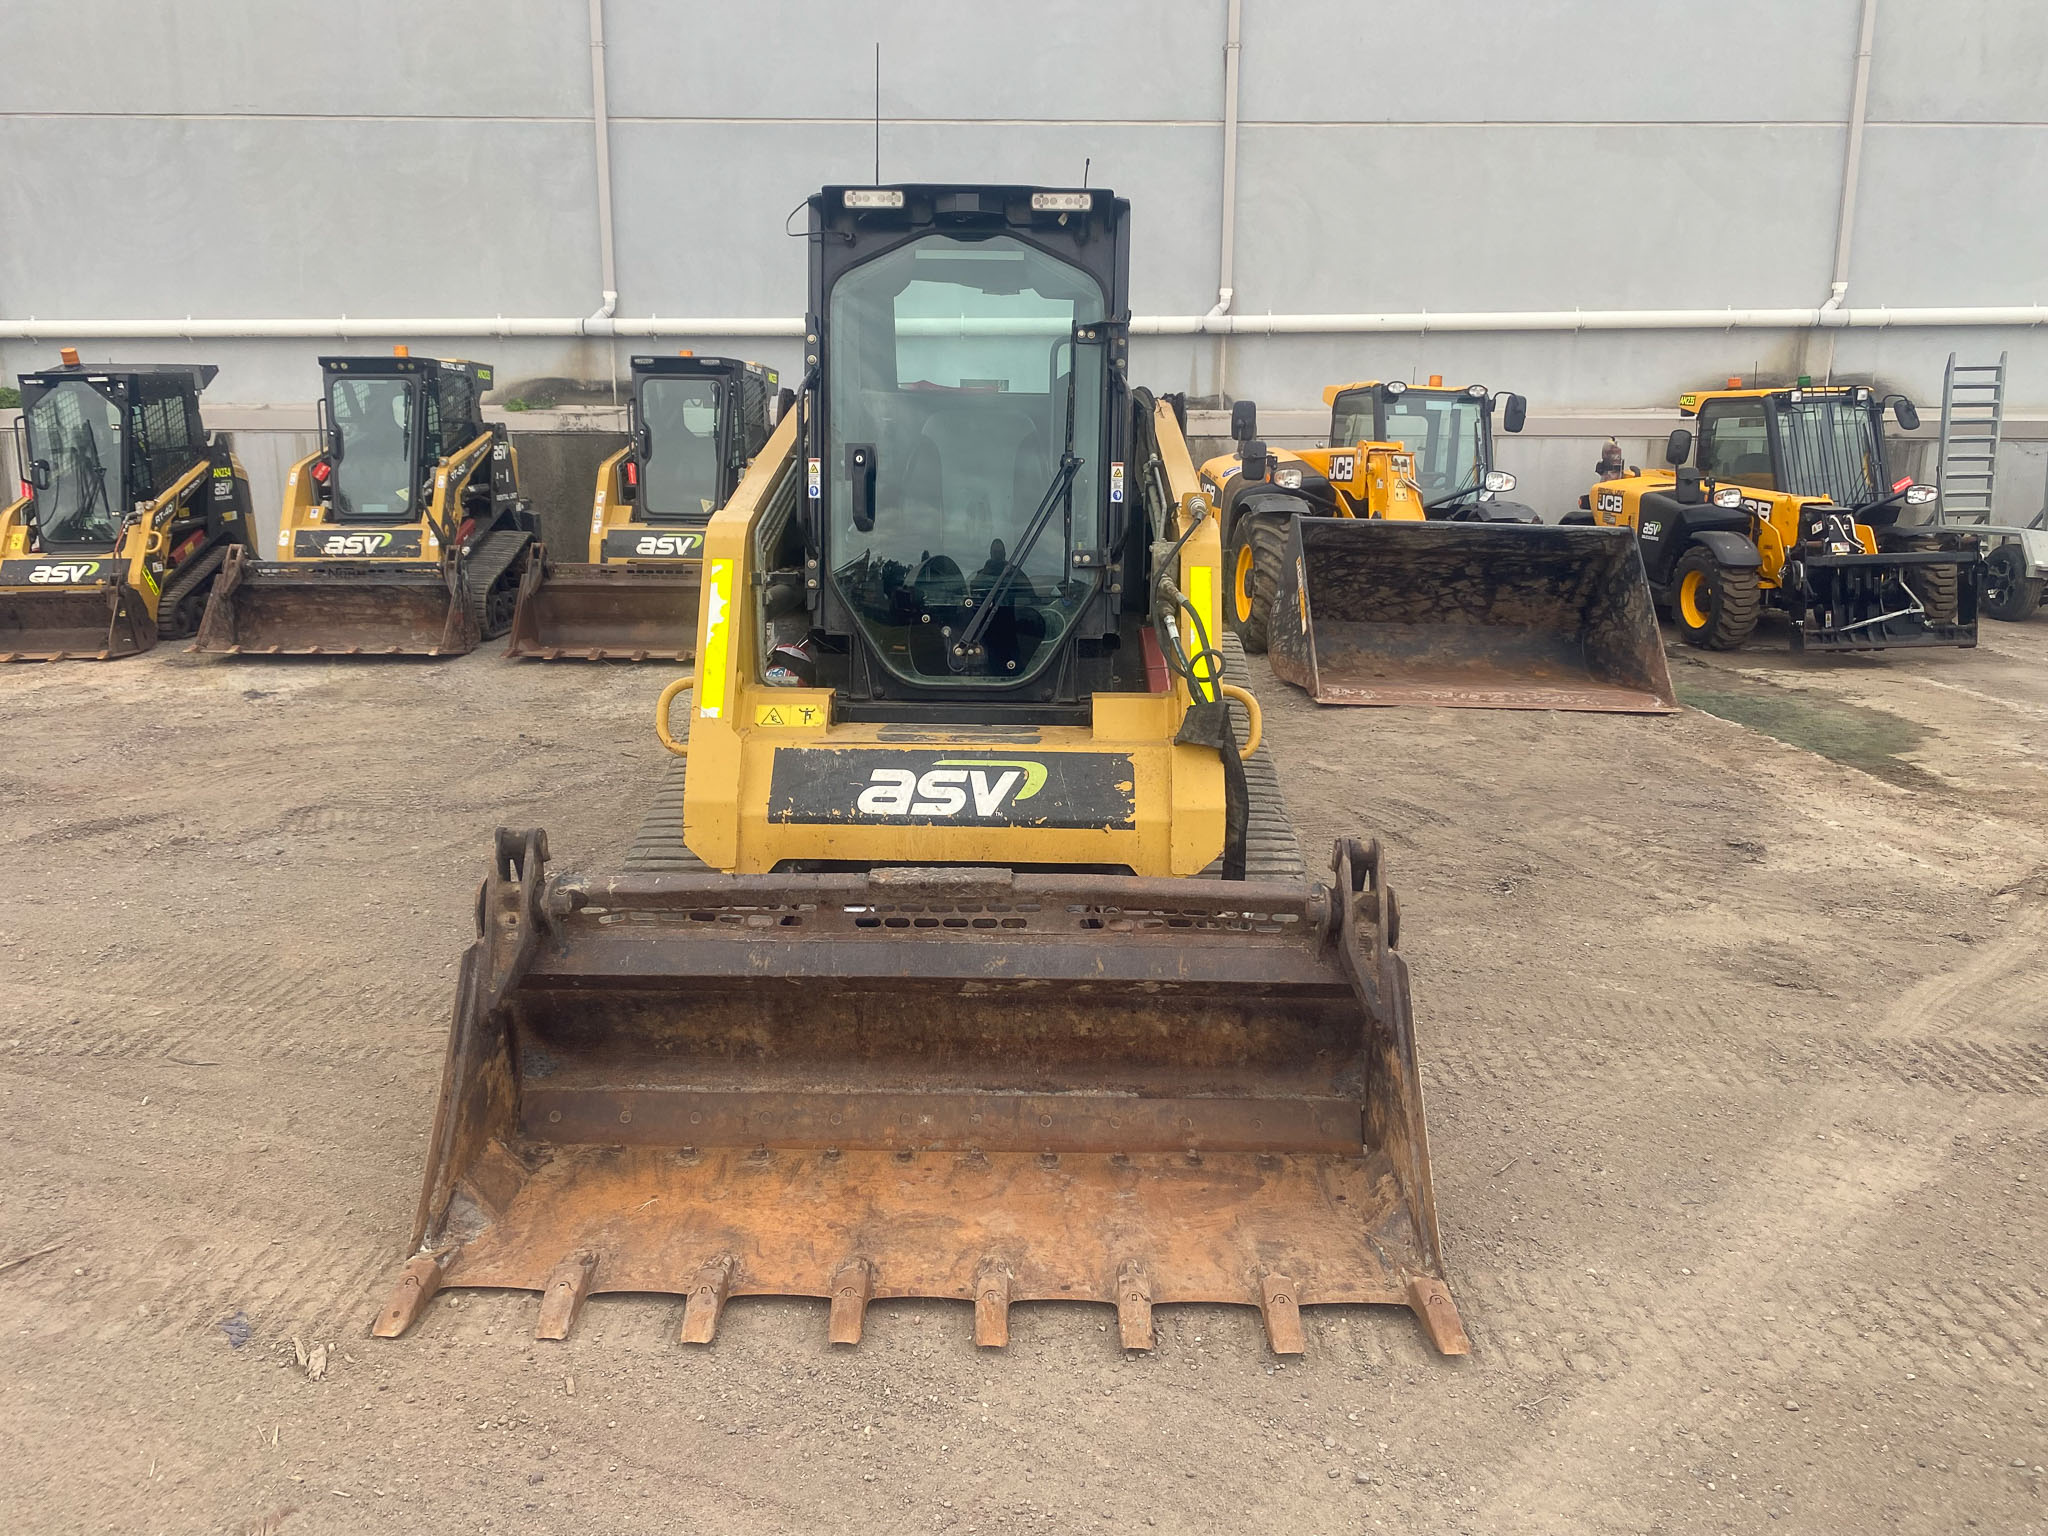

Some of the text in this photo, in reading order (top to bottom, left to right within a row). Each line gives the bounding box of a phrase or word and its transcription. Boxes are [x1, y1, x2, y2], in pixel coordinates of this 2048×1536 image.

[1329, 456, 1354, 480] JCB
[1597, 494, 1622, 513] JCB
[1741, 498, 1771, 522] CB
[1642, 522, 1659, 536] asv
[324, 535, 383, 555] asv
[636, 536, 694, 556] asv
[29, 565, 90, 583] asv
[857, 768, 1021, 817] asv
